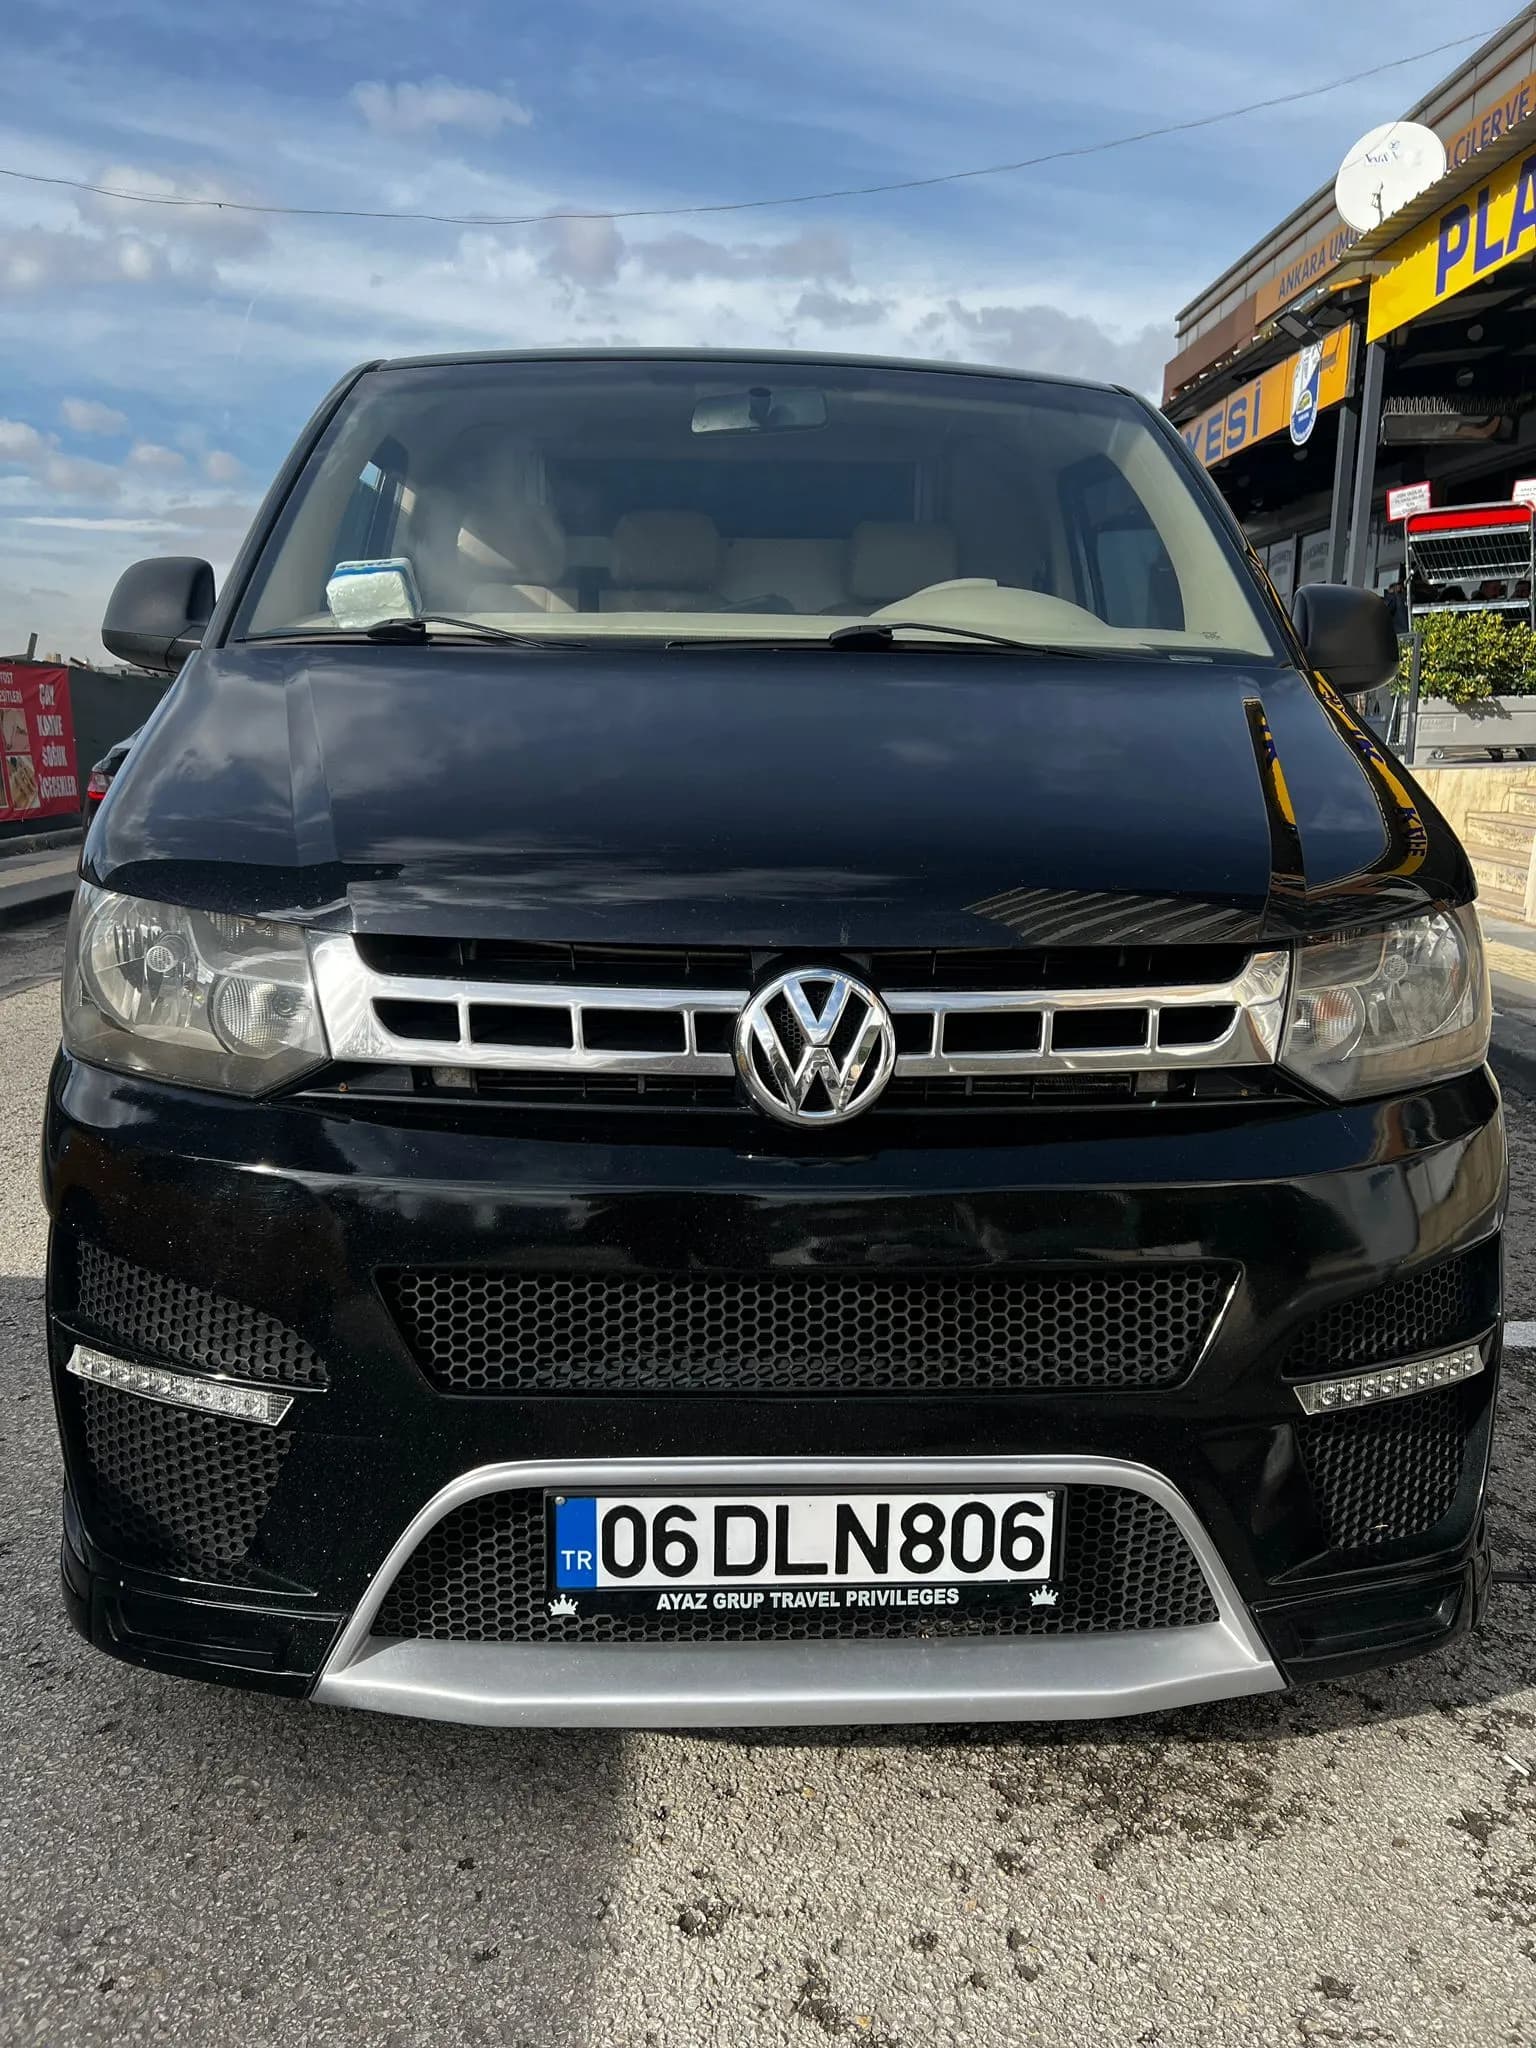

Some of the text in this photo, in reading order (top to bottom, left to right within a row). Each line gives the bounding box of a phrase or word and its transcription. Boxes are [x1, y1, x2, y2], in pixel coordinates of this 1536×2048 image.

[1279, 245, 1326, 298] ANKARA
[560, 1549, 593, 1571] TR
[656, 1588, 960, 1611] AYAZ GRUP TRAVEL PRIVILEGES
